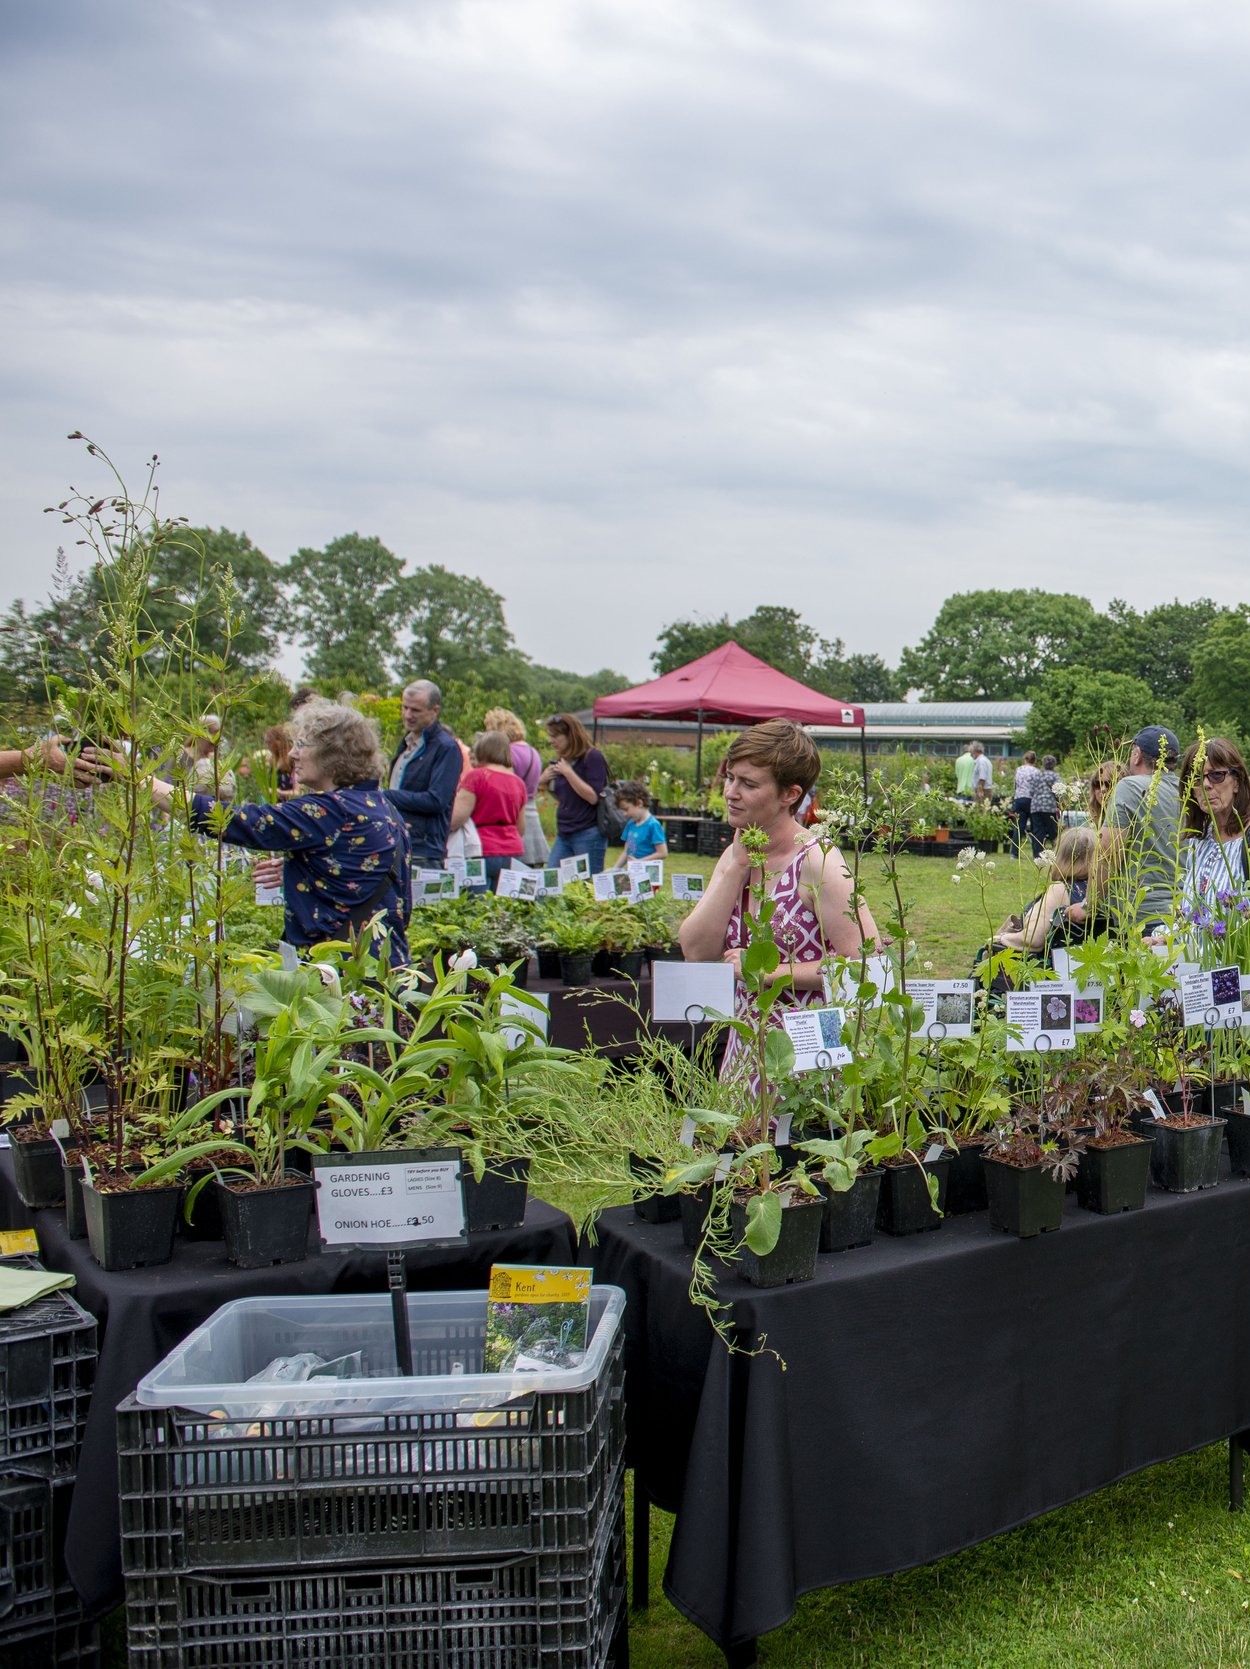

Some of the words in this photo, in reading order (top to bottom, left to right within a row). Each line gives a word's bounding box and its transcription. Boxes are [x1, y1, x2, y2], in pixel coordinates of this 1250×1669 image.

[330, 1172, 390, 1183] GARDENING
[334, 1220, 368, 1229] ONION
[516, 1281, 536, 1292] Kent
